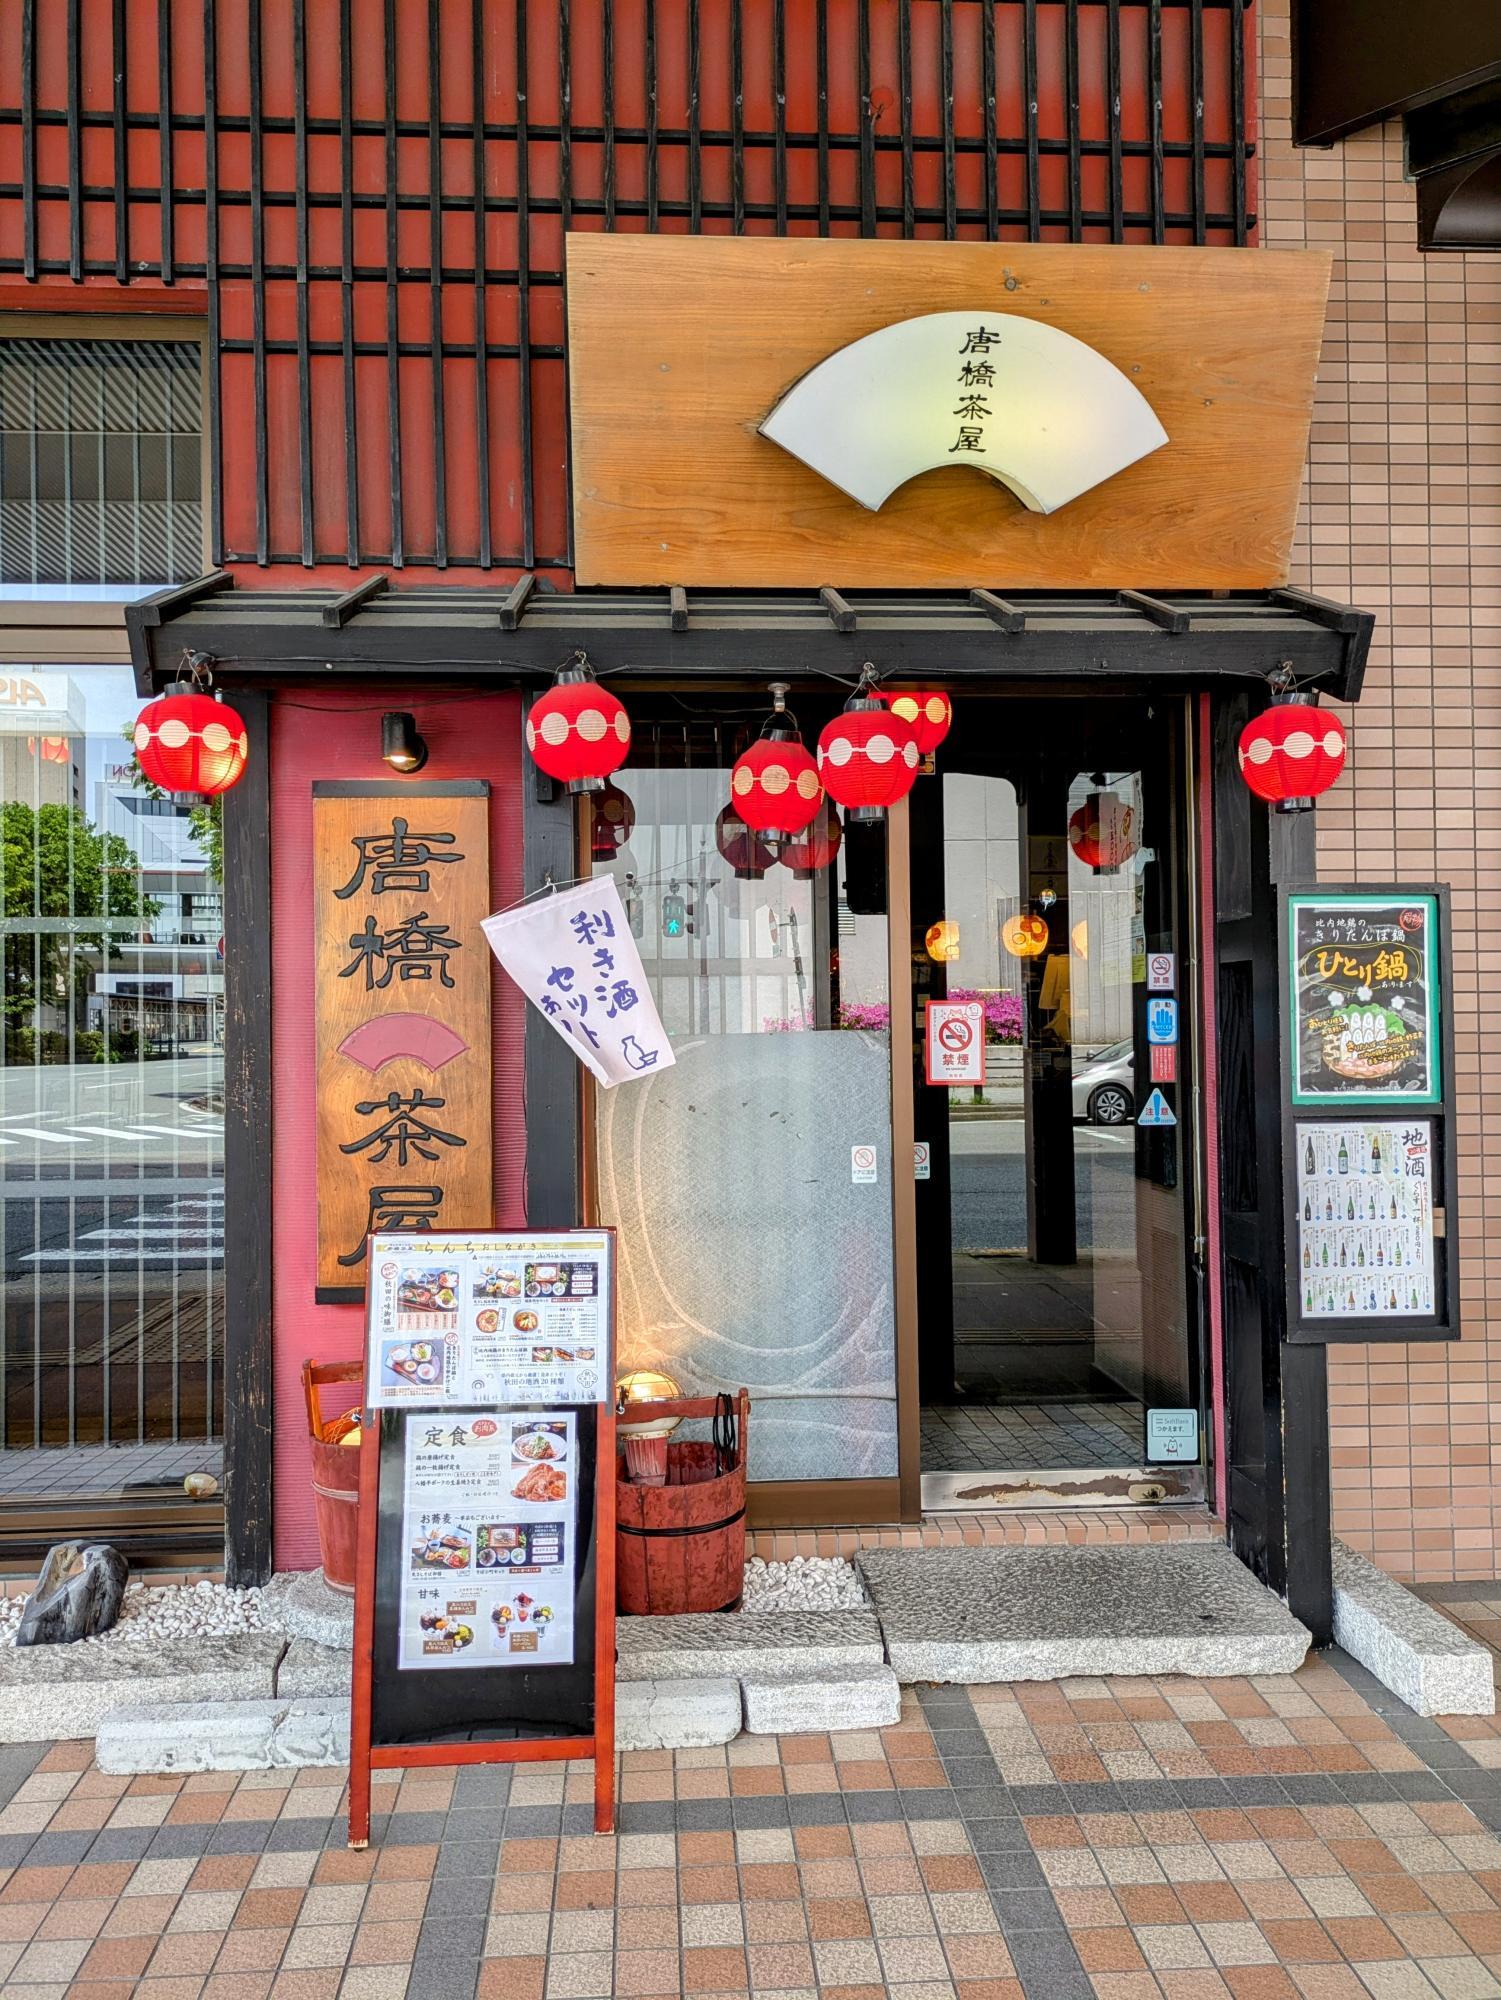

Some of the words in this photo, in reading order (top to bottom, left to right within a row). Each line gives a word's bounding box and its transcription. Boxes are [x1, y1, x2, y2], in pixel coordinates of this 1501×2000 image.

[948, 326, 1001, 454] 唐橋茶屋
[1315, 917, 1366, 928] 比内地鶏の
[570, 909, 638, 1018] 利き酒
[1317, 950, 1409, 986] ひとり鍋
[547, 966, 600, 1049] セット
[942, 1053, 970, 1066] 禁煙
[1145, 1107, 1169, 1116] 注意
[1401, 1127, 1427, 1178] 地酒
[425, 1240, 476, 1255] らんち
[423, 1425, 468, 1448] 定食
[420, 1513, 452, 1525] お蕎麦
[418, 1588, 440, 1600] 甘味
